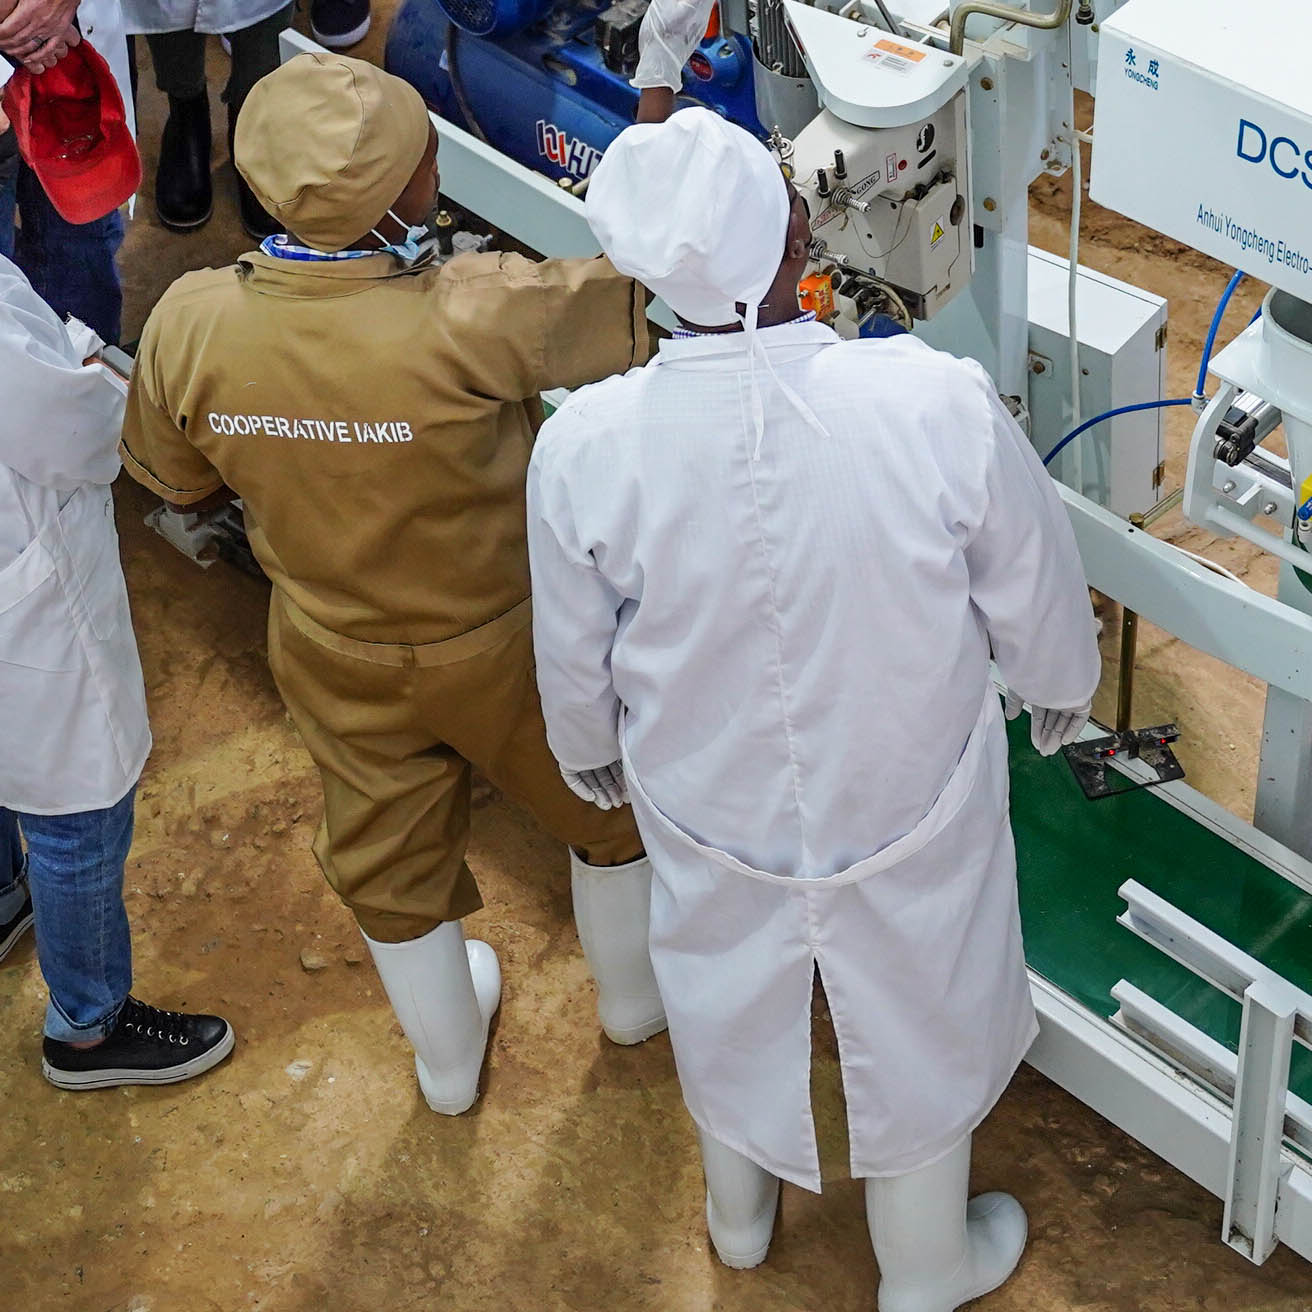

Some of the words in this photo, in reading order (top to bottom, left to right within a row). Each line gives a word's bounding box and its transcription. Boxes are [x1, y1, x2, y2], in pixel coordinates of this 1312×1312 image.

[1124, 68, 1159, 90] YONGCHENG
[1196, 203, 1224, 234] Anhui
[1224, 217, 1275, 264] Yongcheng
[208, 412, 352, 443] COOPERATIVE
[353, 421, 414, 443] IAKIB
